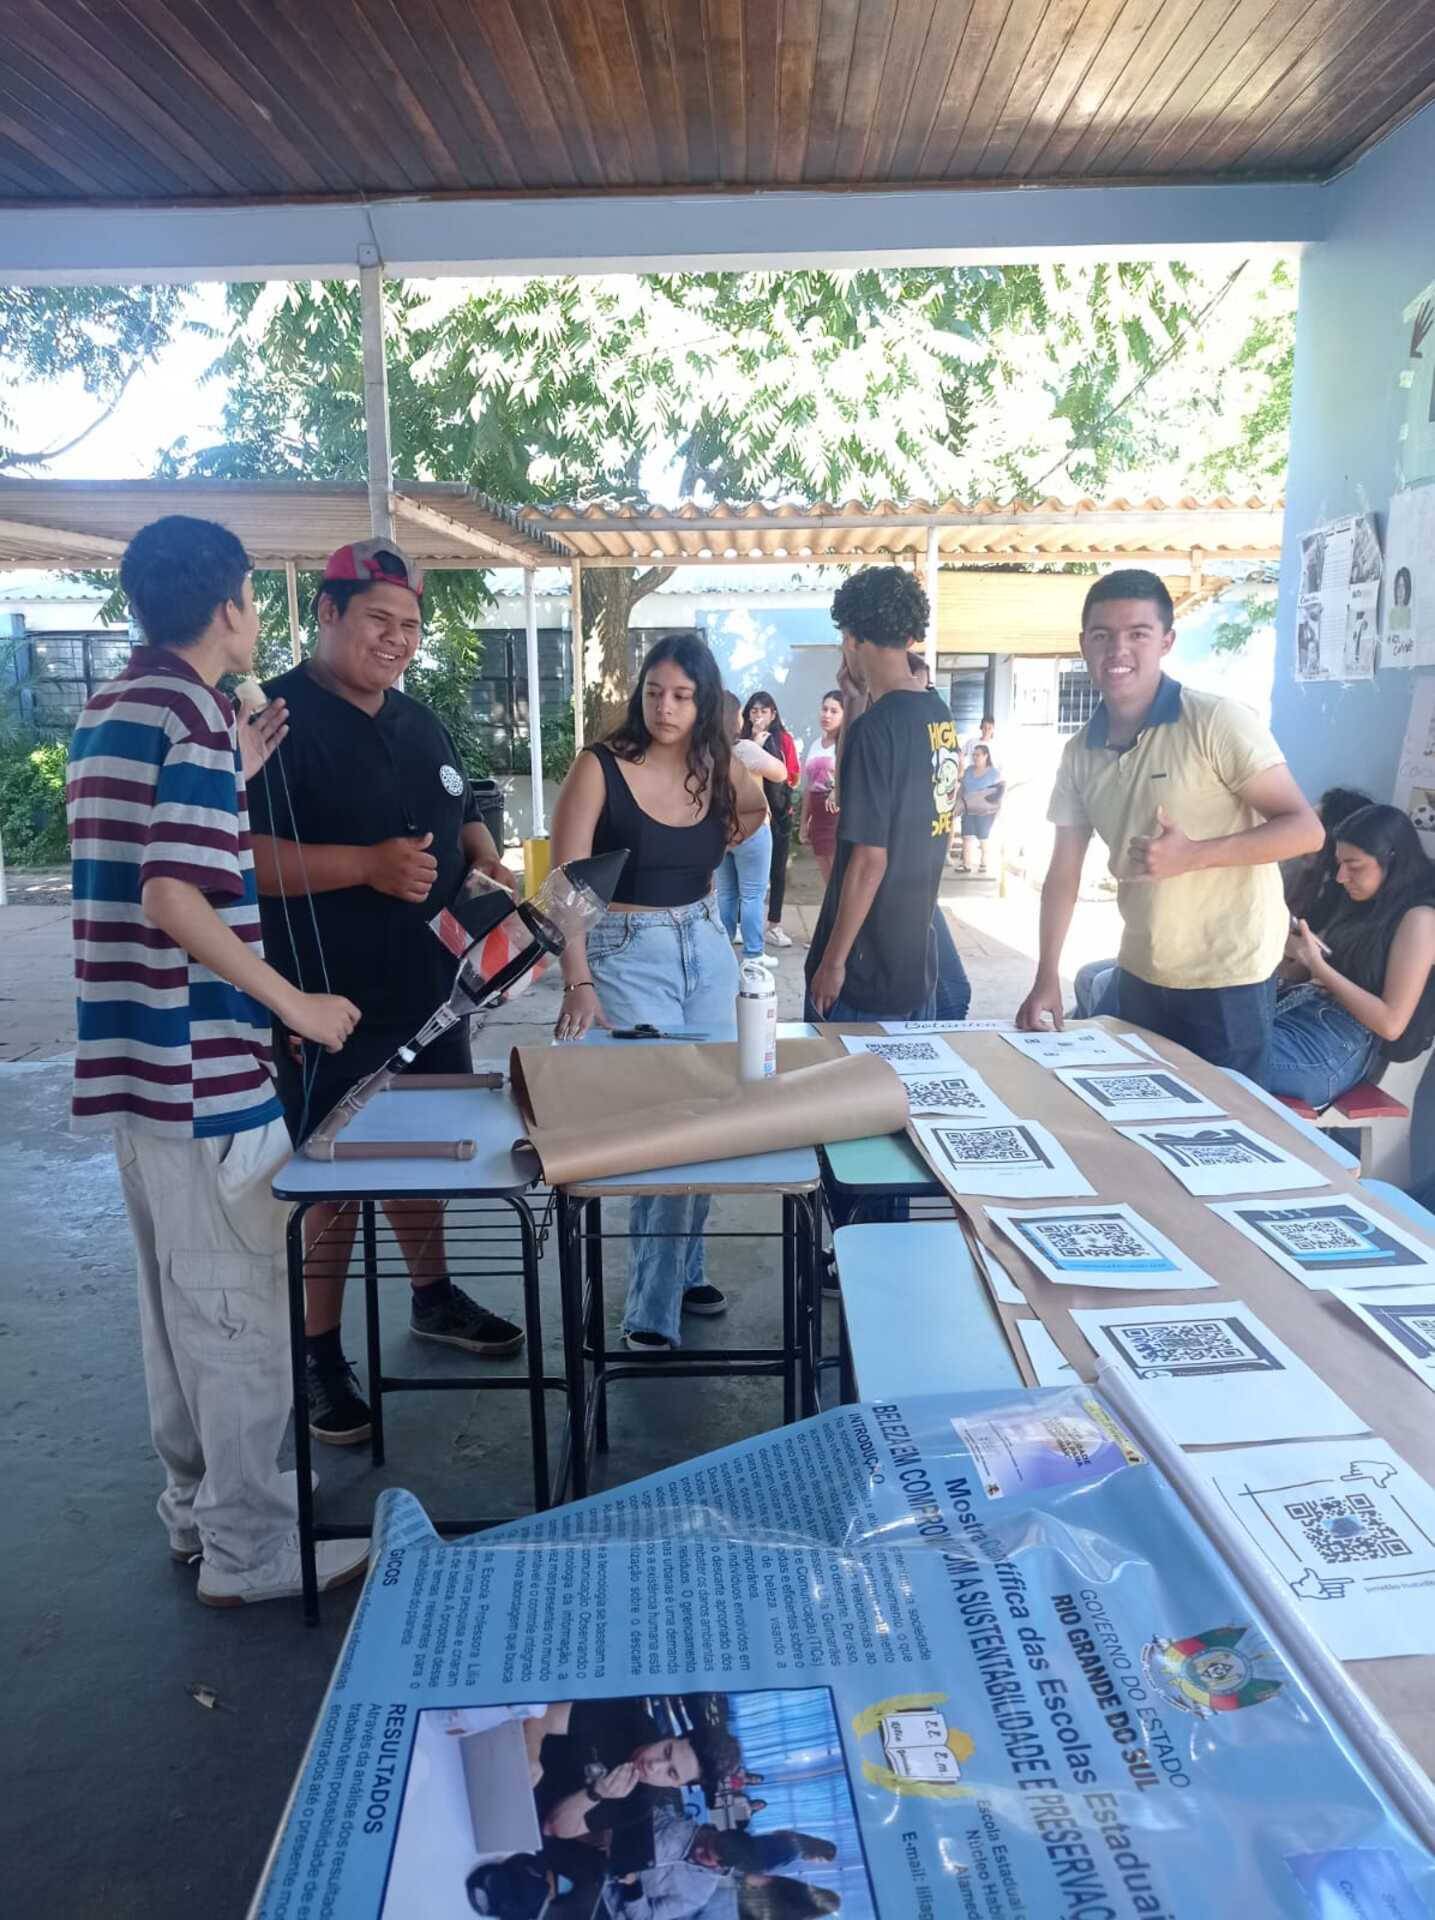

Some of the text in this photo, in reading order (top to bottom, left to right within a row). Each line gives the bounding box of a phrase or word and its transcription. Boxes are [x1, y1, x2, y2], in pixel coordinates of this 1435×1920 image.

[850, 1414, 886, 1485] INTRODUÇÃO
[872, 1405, 913, 1447] BELEZA
[890, 1446, 922, 1467] EM
[681, 1590, 693, 1598] O
[743, 1544, 759, 1599] emporânea.
[951, 1579, 982, 1591] A
[630, 1587, 641, 1613] sobre
[665, 1605, 676, 1625] uma
[695, 1543, 707, 1576] mbater
[701, 1619, 715, 1671] ambientais
[712, 1555, 725, 1596] descarte
[721, 1653, 733, 1671] dos
[761, 1555, 773, 1568] de
[770, 1617, 786, 1655] visando
[783, 1584, 799, 1630] eficientes
[796, 1566, 817, 1634] Comunicação
[807, 1636, 824, 1667] (TICs)
[648, 1612, 660, 1650] humana
[679, 1602, 697, 1673] gerenciamento
[734, 1602, 749, 1651] envolvidos
[790, 1632, 805, 1659] sobre
[821, 1613, 841, 1666] Guimarães
[842, 1623, 856, 1641] Por
[908, 1608, 932, 1661] sociedade
[945, 1477, 987, 1542] Mostra
[1018, 1628, 1051, 1670] das
[1037, 1679, 1097, 1784] Escolas
[630, 1631, 642, 1675] descarte
[666, 1628, 681, 1674] demanda
[739, 1655, 751, 1671] em
[866, 1652, 878, 1664] ao
[897, 1643, 913, 1662] que
[957, 1592, 1050, 1773] SUSTENTABILIDADE
[1052, 1593, 1159, 1792] RIO GRANDE DO SUL
[1080, 1590, 1190, 1788] GOVERNO DO ESTADO
[311, 1704, 342, 1781] encontrados
[340, 1703, 364, 1752] trabalho
[360, 1704, 383, 1749] Através
[332, 1754, 350, 1780] tem
[356, 1751, 371, 1767] da
[363, 1704, 407, 1834] RESULTADOS
[305, 1783, 322, 1805] até
[344, 1770, 367, 1819] análise
[1018, 1778, 1058, 1790] E
[302, 1808, 315, 1817] o
[307, 1782, 342, 1878] possibilidade
[337, 1821, 354, 1848] dos
[283, 1820, 311, 1888] presente
[902, 1832, 926, 1881] E-mail:
[965, 1829, 990, 1880] Núcleo
[977, 1800, 998, 1841] Escola
[992, 1844, 1023, 1911] Estadual
[300, 1881, 317, 1903] de
